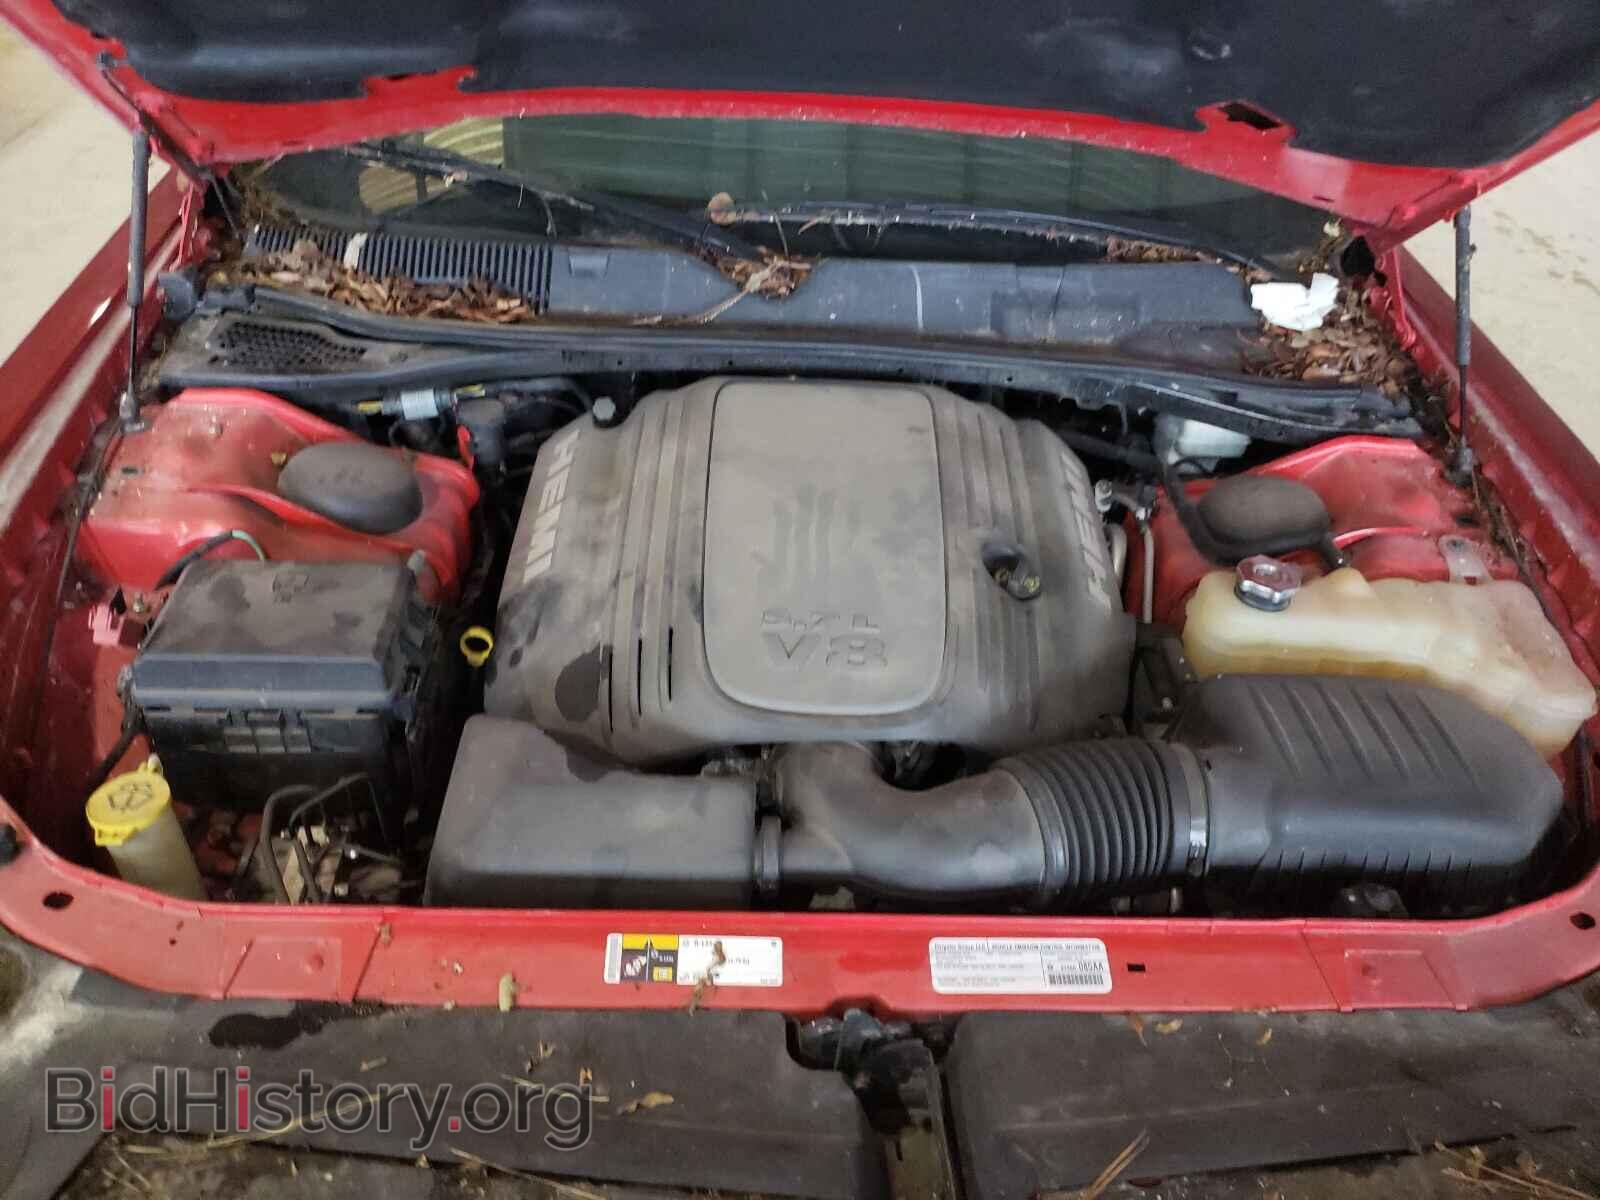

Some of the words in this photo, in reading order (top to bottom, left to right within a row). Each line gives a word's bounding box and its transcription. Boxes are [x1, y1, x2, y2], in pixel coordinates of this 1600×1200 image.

[523, 429, 580, 584] HEMI
[761, 607, 881, 632] 5.7L
[761, 632, 889, 672] V8
